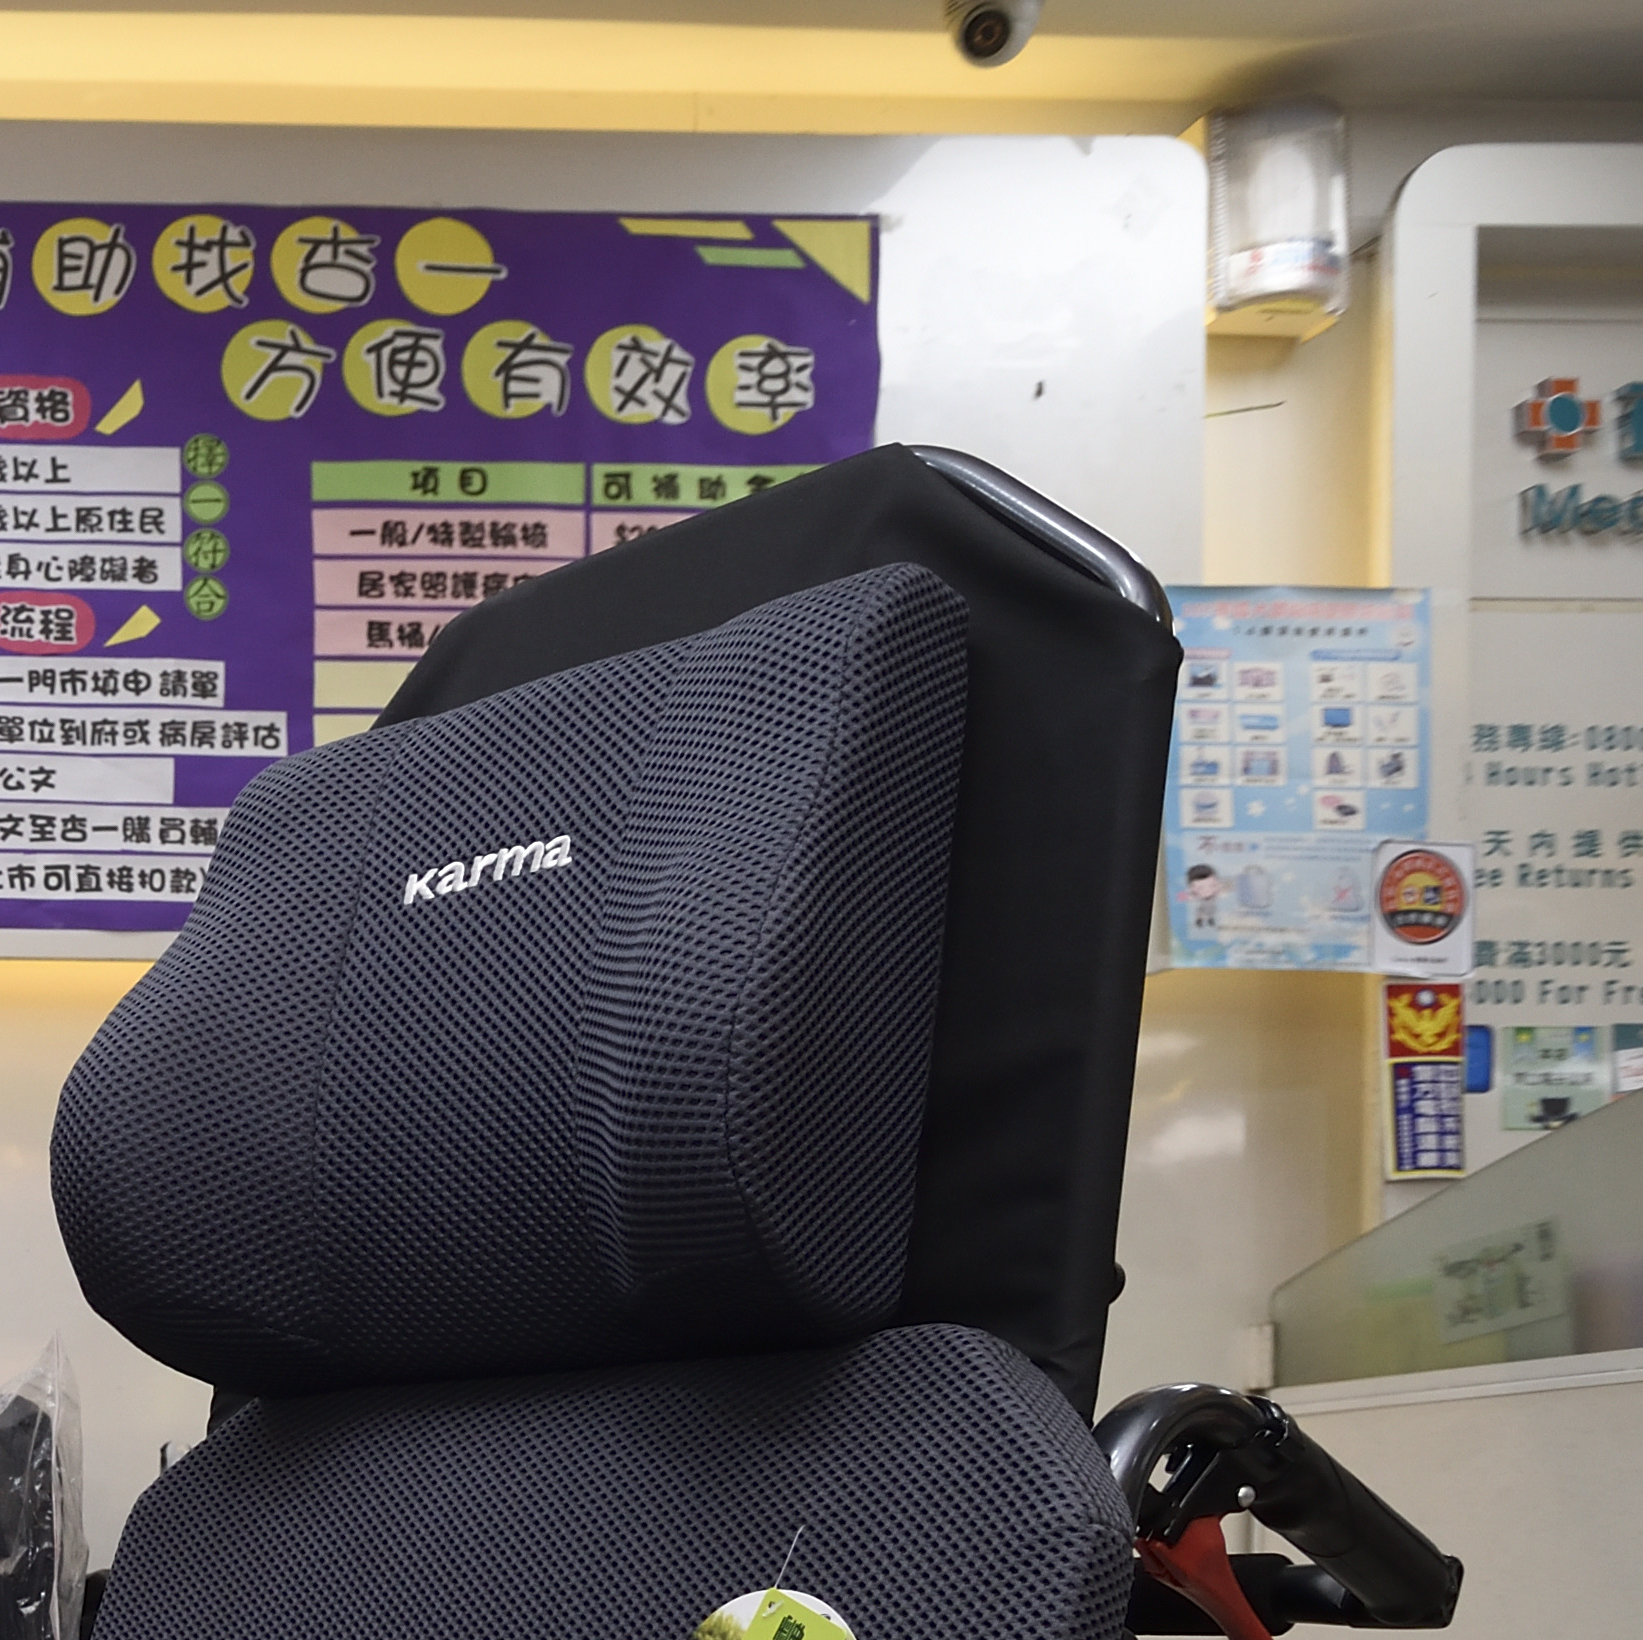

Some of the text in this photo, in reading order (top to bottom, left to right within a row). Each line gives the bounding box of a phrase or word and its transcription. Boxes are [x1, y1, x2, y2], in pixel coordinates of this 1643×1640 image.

[242, 328, 812, 420] 方便有效率
[411, 467, 488, 497] 項目
[604, 472, 803, 501] 可補助金
[0, 605, 76, 643] 流程
[1587, 761, 1643, 786] Hot
